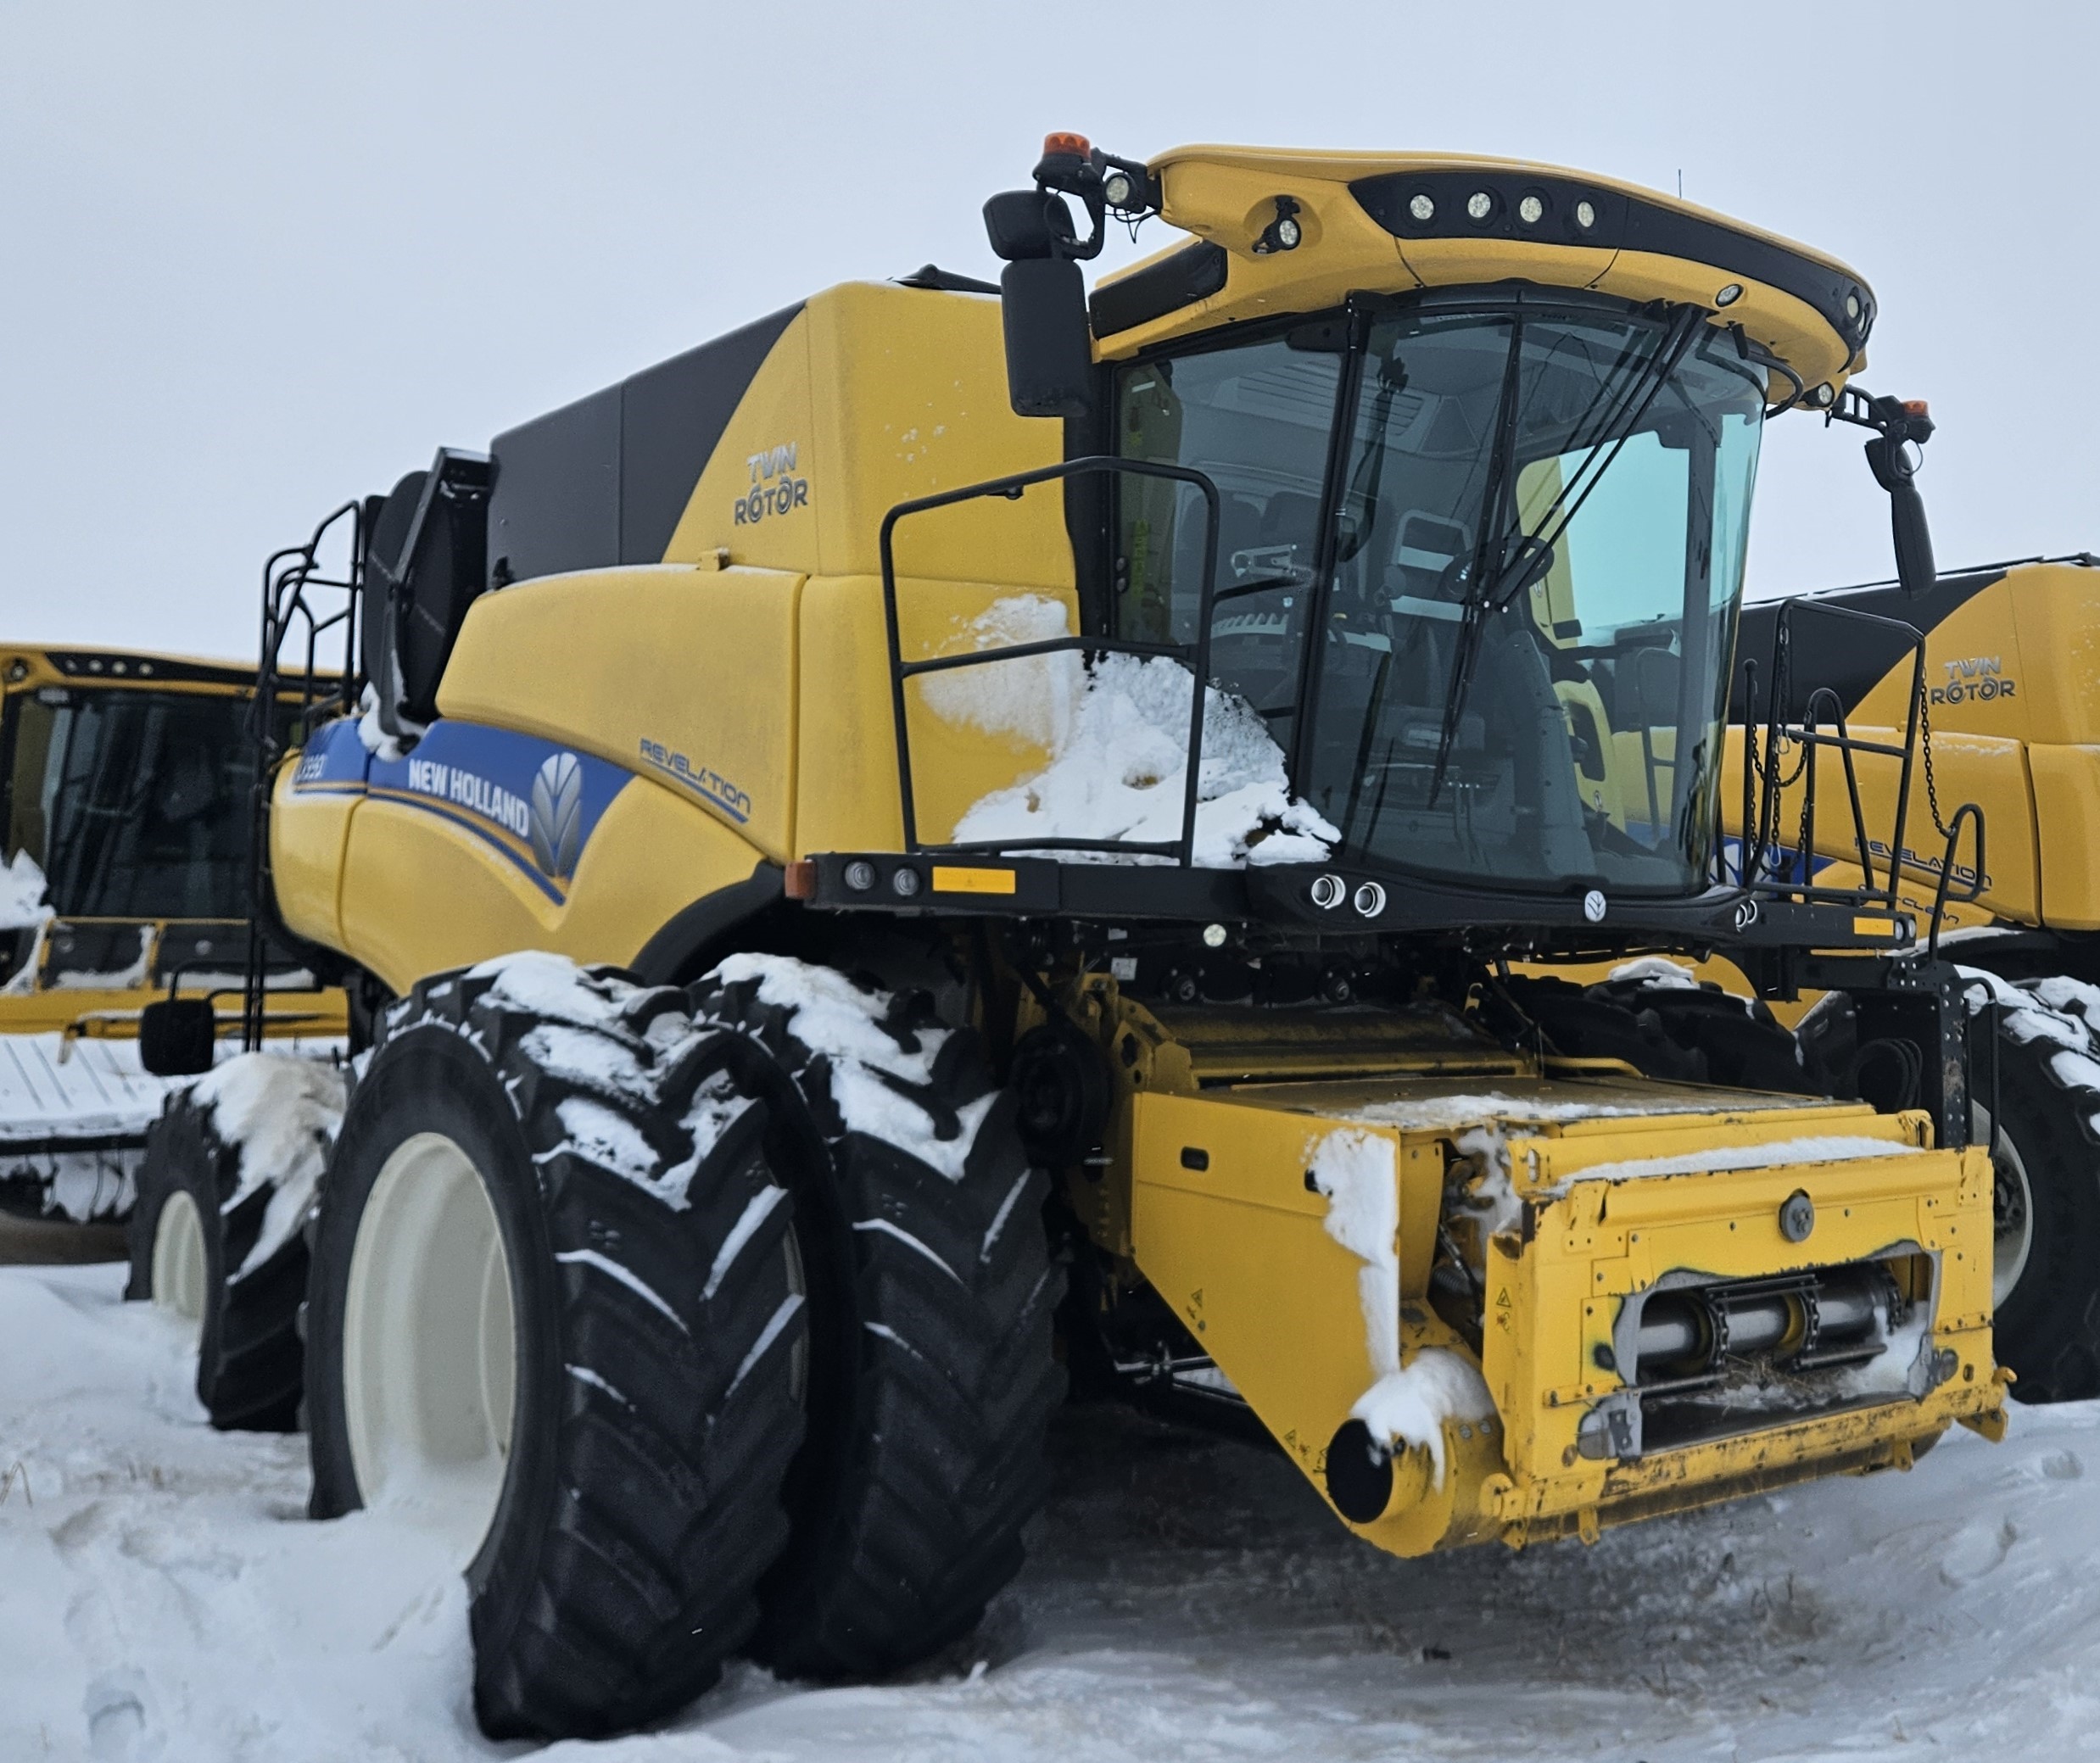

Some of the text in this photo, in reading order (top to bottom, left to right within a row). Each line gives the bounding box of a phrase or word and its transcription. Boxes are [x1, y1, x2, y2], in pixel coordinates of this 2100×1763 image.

[746, 441, 797, 483] TWIN
[734, 476, 808, 526] ROTOR
[1930, 676, 2016, 706] ROTOR
[1943, 656, 2001, 679] TWIN
[409, 758, 530, 837] NEW HOLLAND
[640, 738, 751, 815] REVELATION
[1854, 836, 1992, 888] EVELAION
